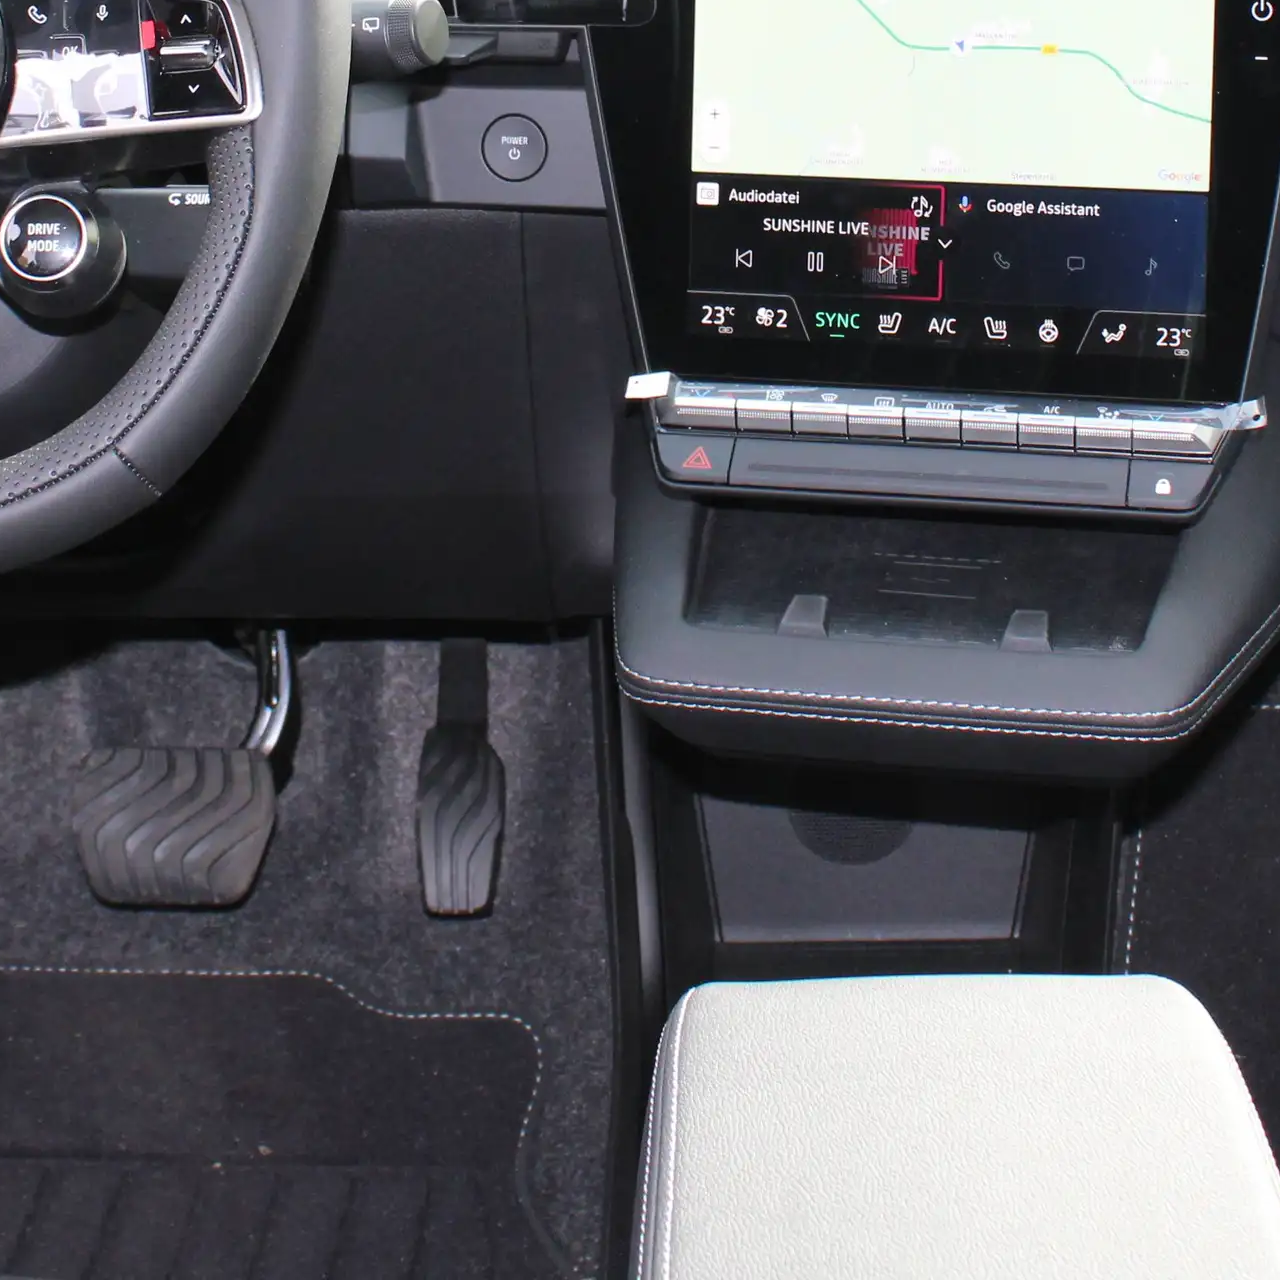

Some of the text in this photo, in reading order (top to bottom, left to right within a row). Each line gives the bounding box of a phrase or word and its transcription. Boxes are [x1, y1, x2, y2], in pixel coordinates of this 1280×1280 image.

[501, 136, 528, 145] POWER
[728, 187, 800, 205] Audiodatei
[987, 198, 1101, 217] Google Assistant
[27, 223, 61, 236] DRIVE
[763, 217, 869, 236] SUNSHINE LIVE
[27, 239, 59, 252] MODE
[867, 242, 904, 256] LIVE
[776, 309, 788, 328] 2
[815, 312, 860, 329] SYNC
[928, 317, 957, 334] A/C
[1043, 406, 1061, 415] A/C
